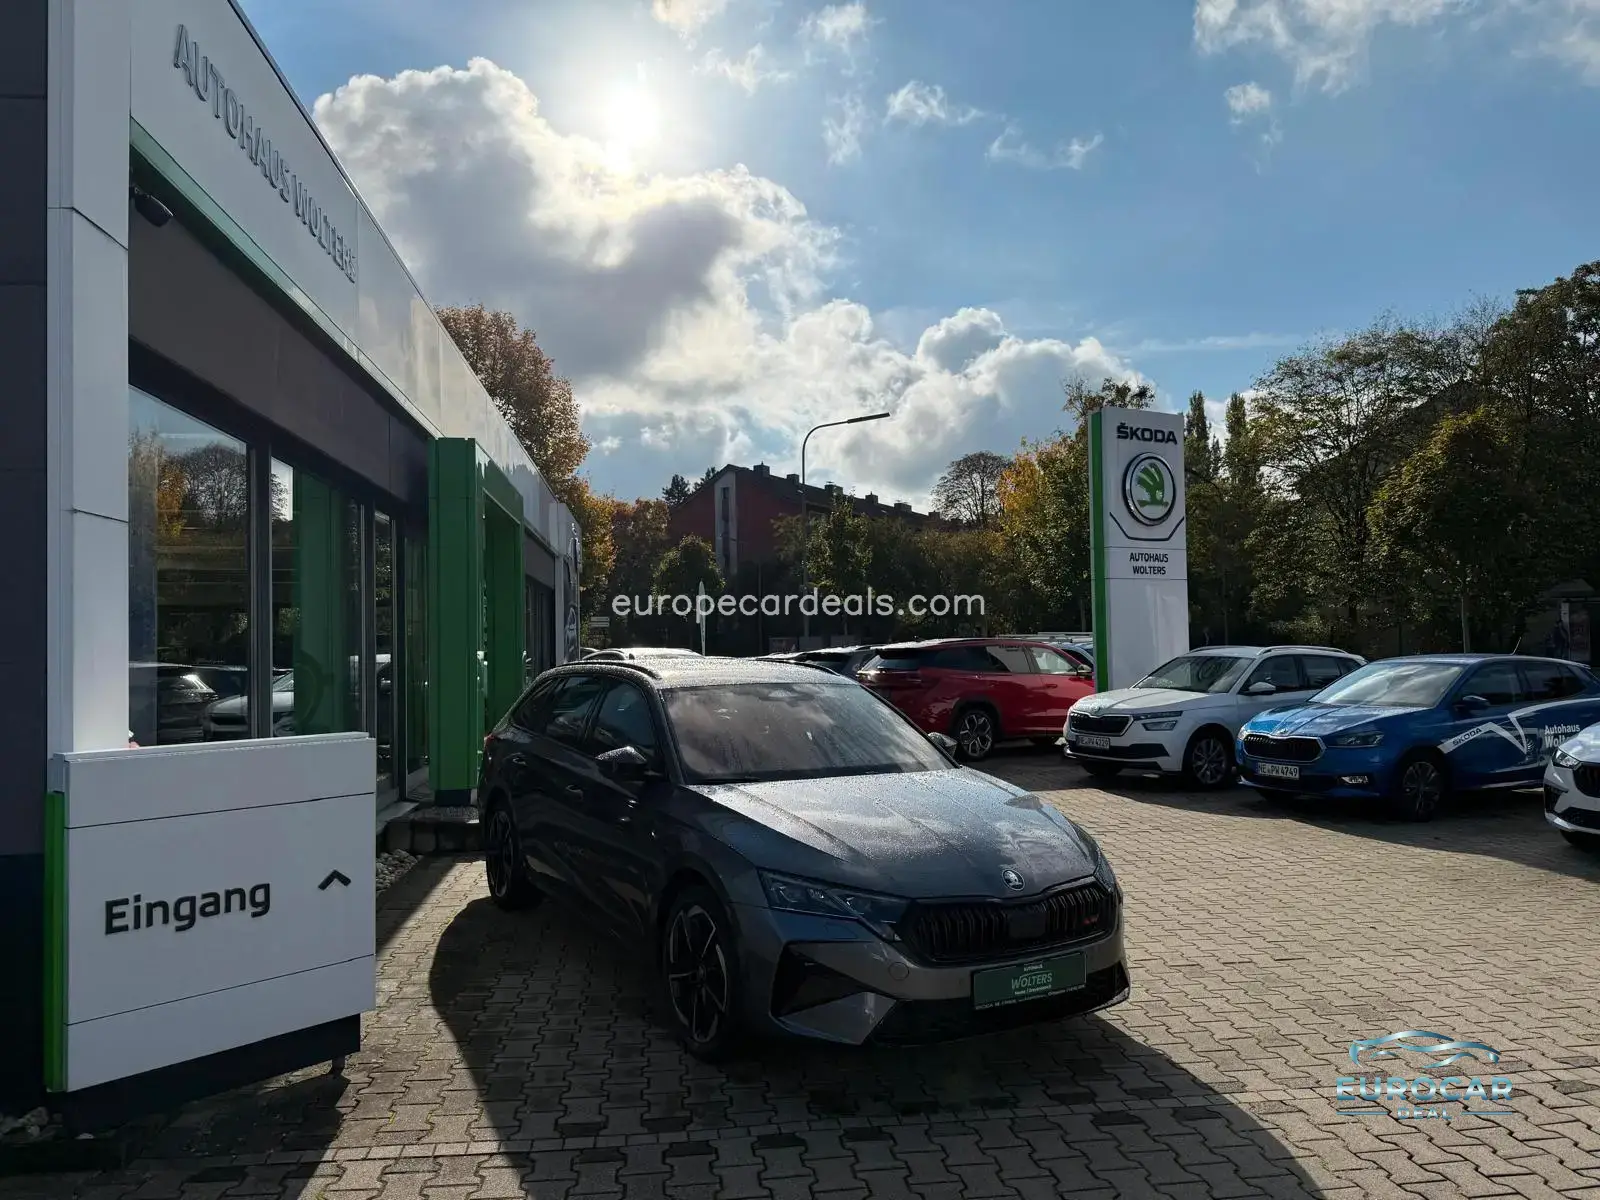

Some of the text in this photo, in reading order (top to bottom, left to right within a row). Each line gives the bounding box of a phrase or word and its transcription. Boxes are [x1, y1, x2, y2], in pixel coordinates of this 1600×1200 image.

[173, 24, 356, 284] AUTOHAUS WOLTERS
[1116, 422, 1178, 445] ŠKODA
[1129, 551, 1169, 563] AUTOHAUS
[1132, 565, 1166, 575] WOLTERS
[1544, 724, 1581, 735] Autohaus
[104, 883, 271, 936] Eingang
[1011, 972, 1053, 990] WOLTERS
